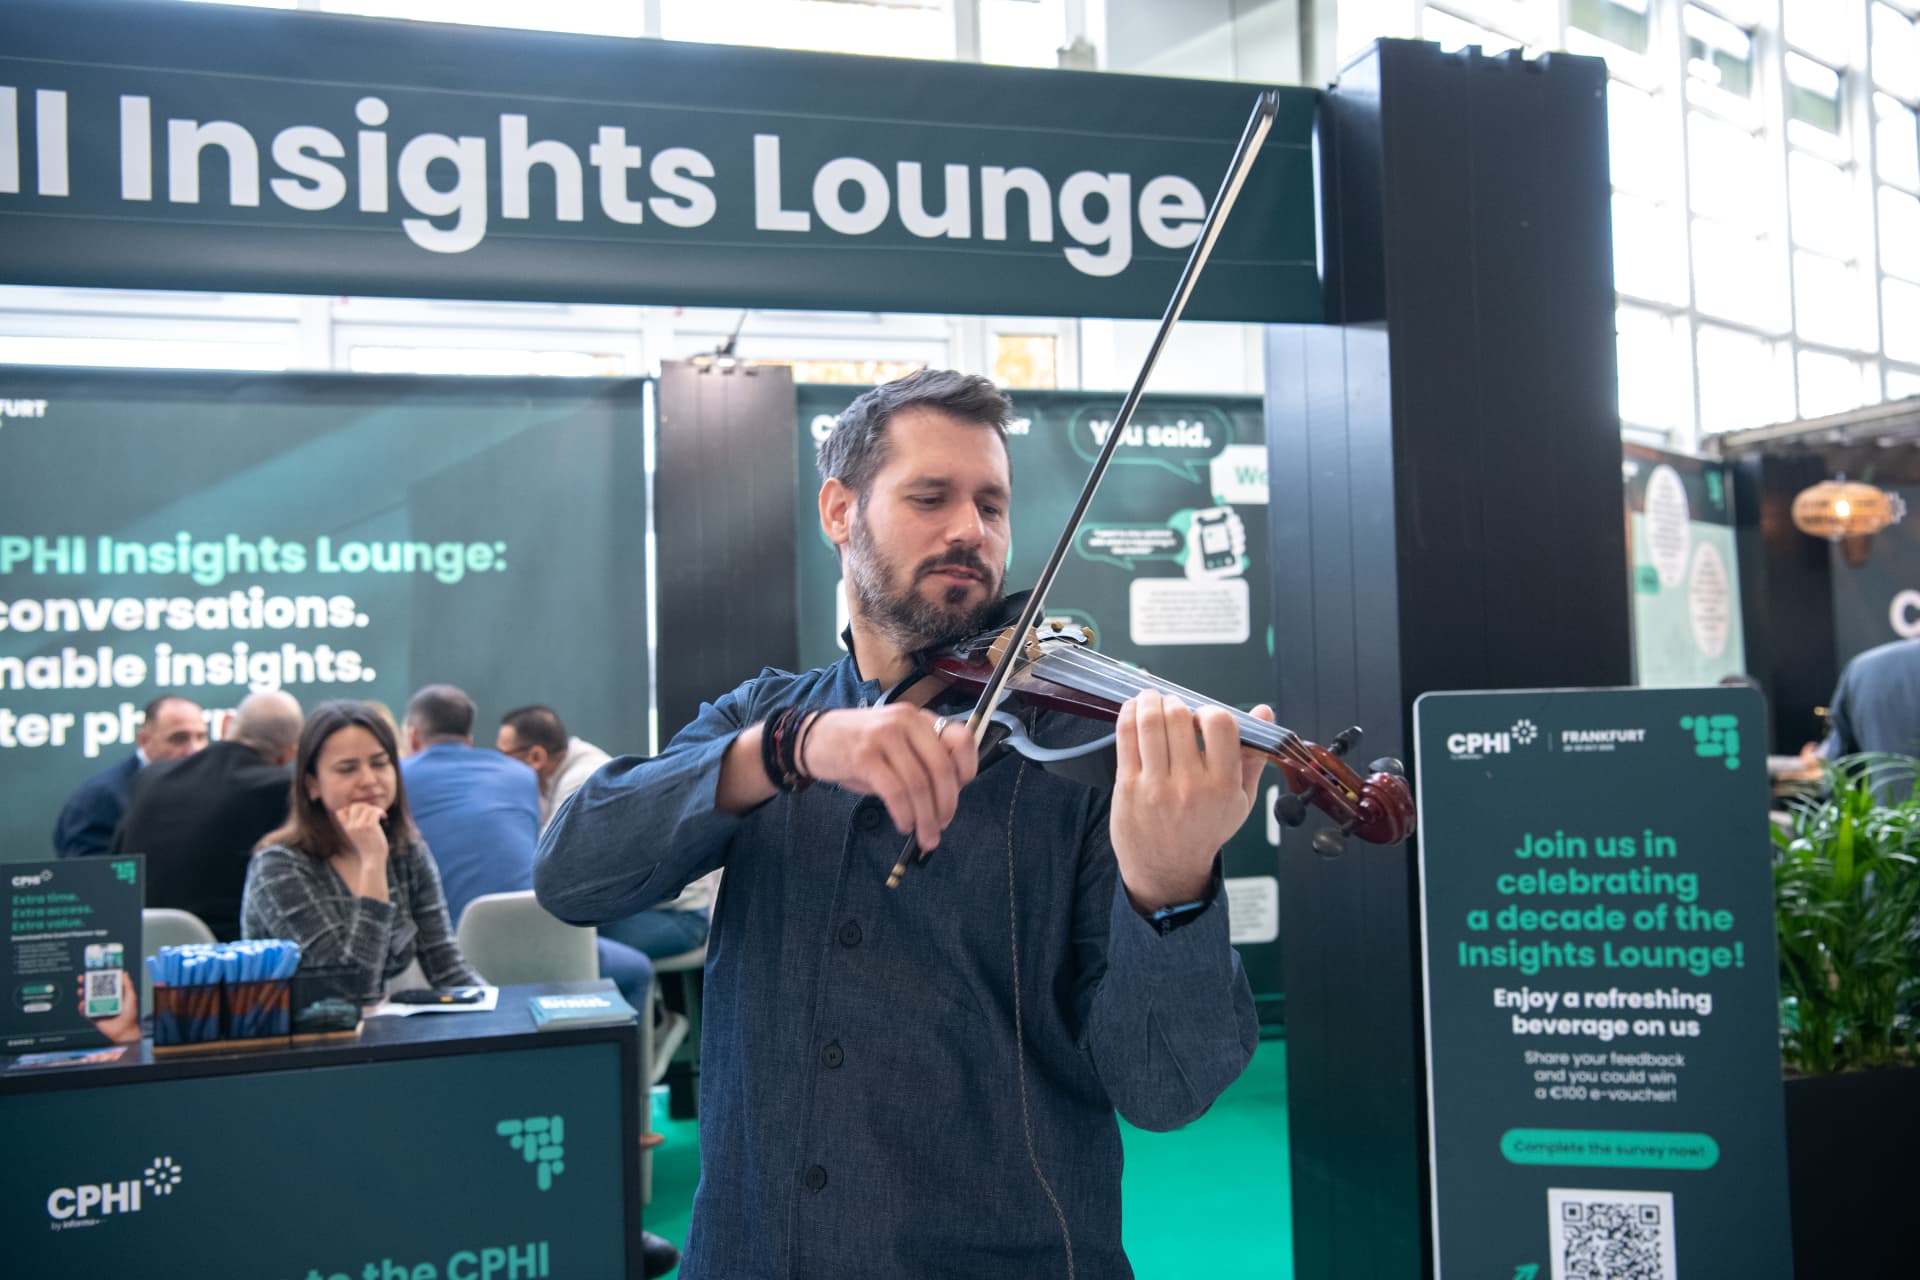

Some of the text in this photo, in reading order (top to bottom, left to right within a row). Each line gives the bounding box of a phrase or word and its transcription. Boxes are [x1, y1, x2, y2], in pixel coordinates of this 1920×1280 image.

[0, 86, 1206, 277] I Insights Lounge
[1089, 420, 1212, 448] Yu said.
[0, 531, 507, 586] PHI Insights Lounge:
[0, 586, 370, 632] onversations.
[155, 641, 377, 692] insights.
[1448, 733, 1511, 753] CPHI
[1561, 729, 1645, 743] FRANKFURT
[1515, 829, 1677, 859] Join us in
[1496, 866, 1698, 901] celebrating
[1467, 903, 1734, 931] a decade of the
[1458, 939, 1744, 976] Insights Lounge!
[1493, 987, 1712, 1015] Enjoy a refreshing
[1512, 1015, 1700, 1041] beverage on us
[1524, 1051, 1685, 1068] Share your feedback
[1534, 1070, 1677, 1085] and you could win
[1534, 1087, 1547, 1100] a
[48, 1180, 141, 1219] CPHI
[447, 1242, 549, 1280] CPHI
